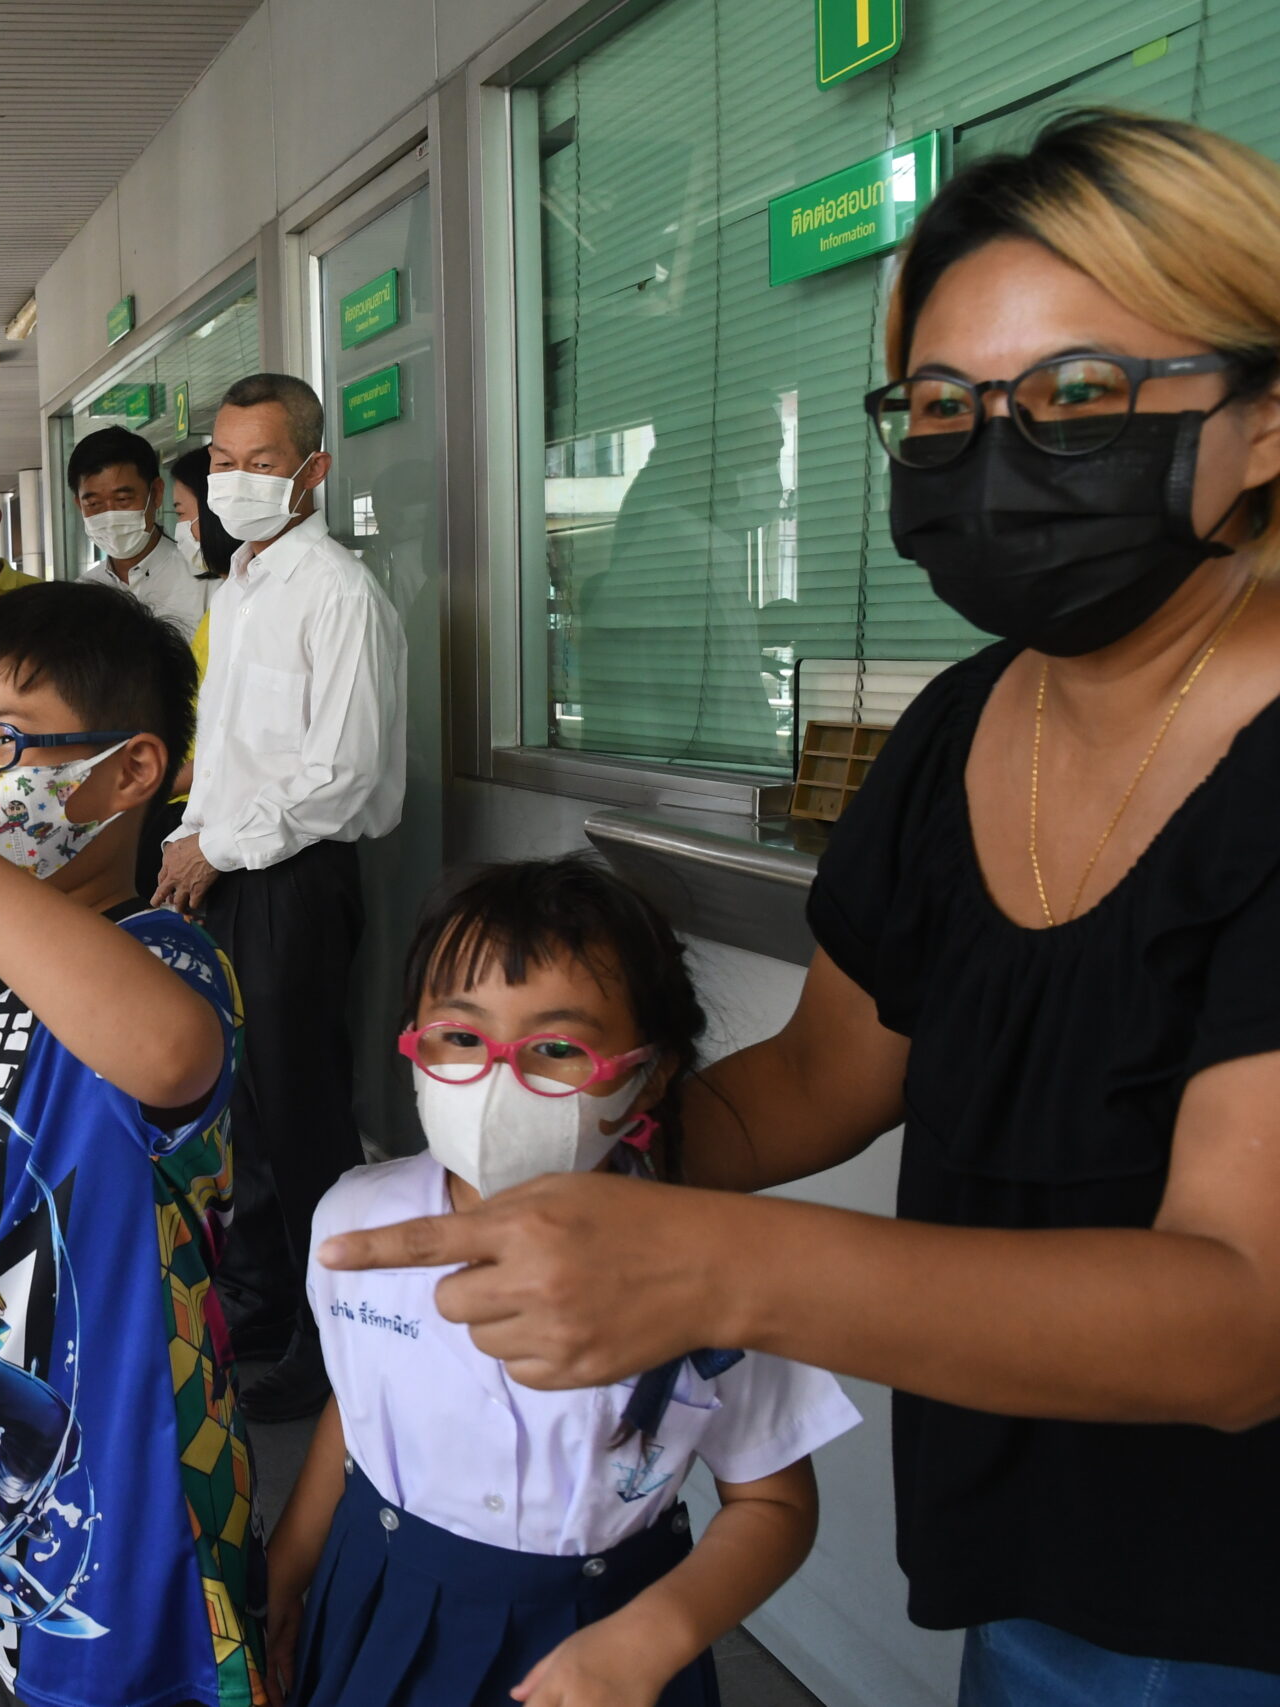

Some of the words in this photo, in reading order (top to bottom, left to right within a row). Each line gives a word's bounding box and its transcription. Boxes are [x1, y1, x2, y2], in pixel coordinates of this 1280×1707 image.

[791, 176, 894, 237] ติดต่อสอบถ
[820, 222, 876, 252] Information
[176, 393, 185, 431] 2
